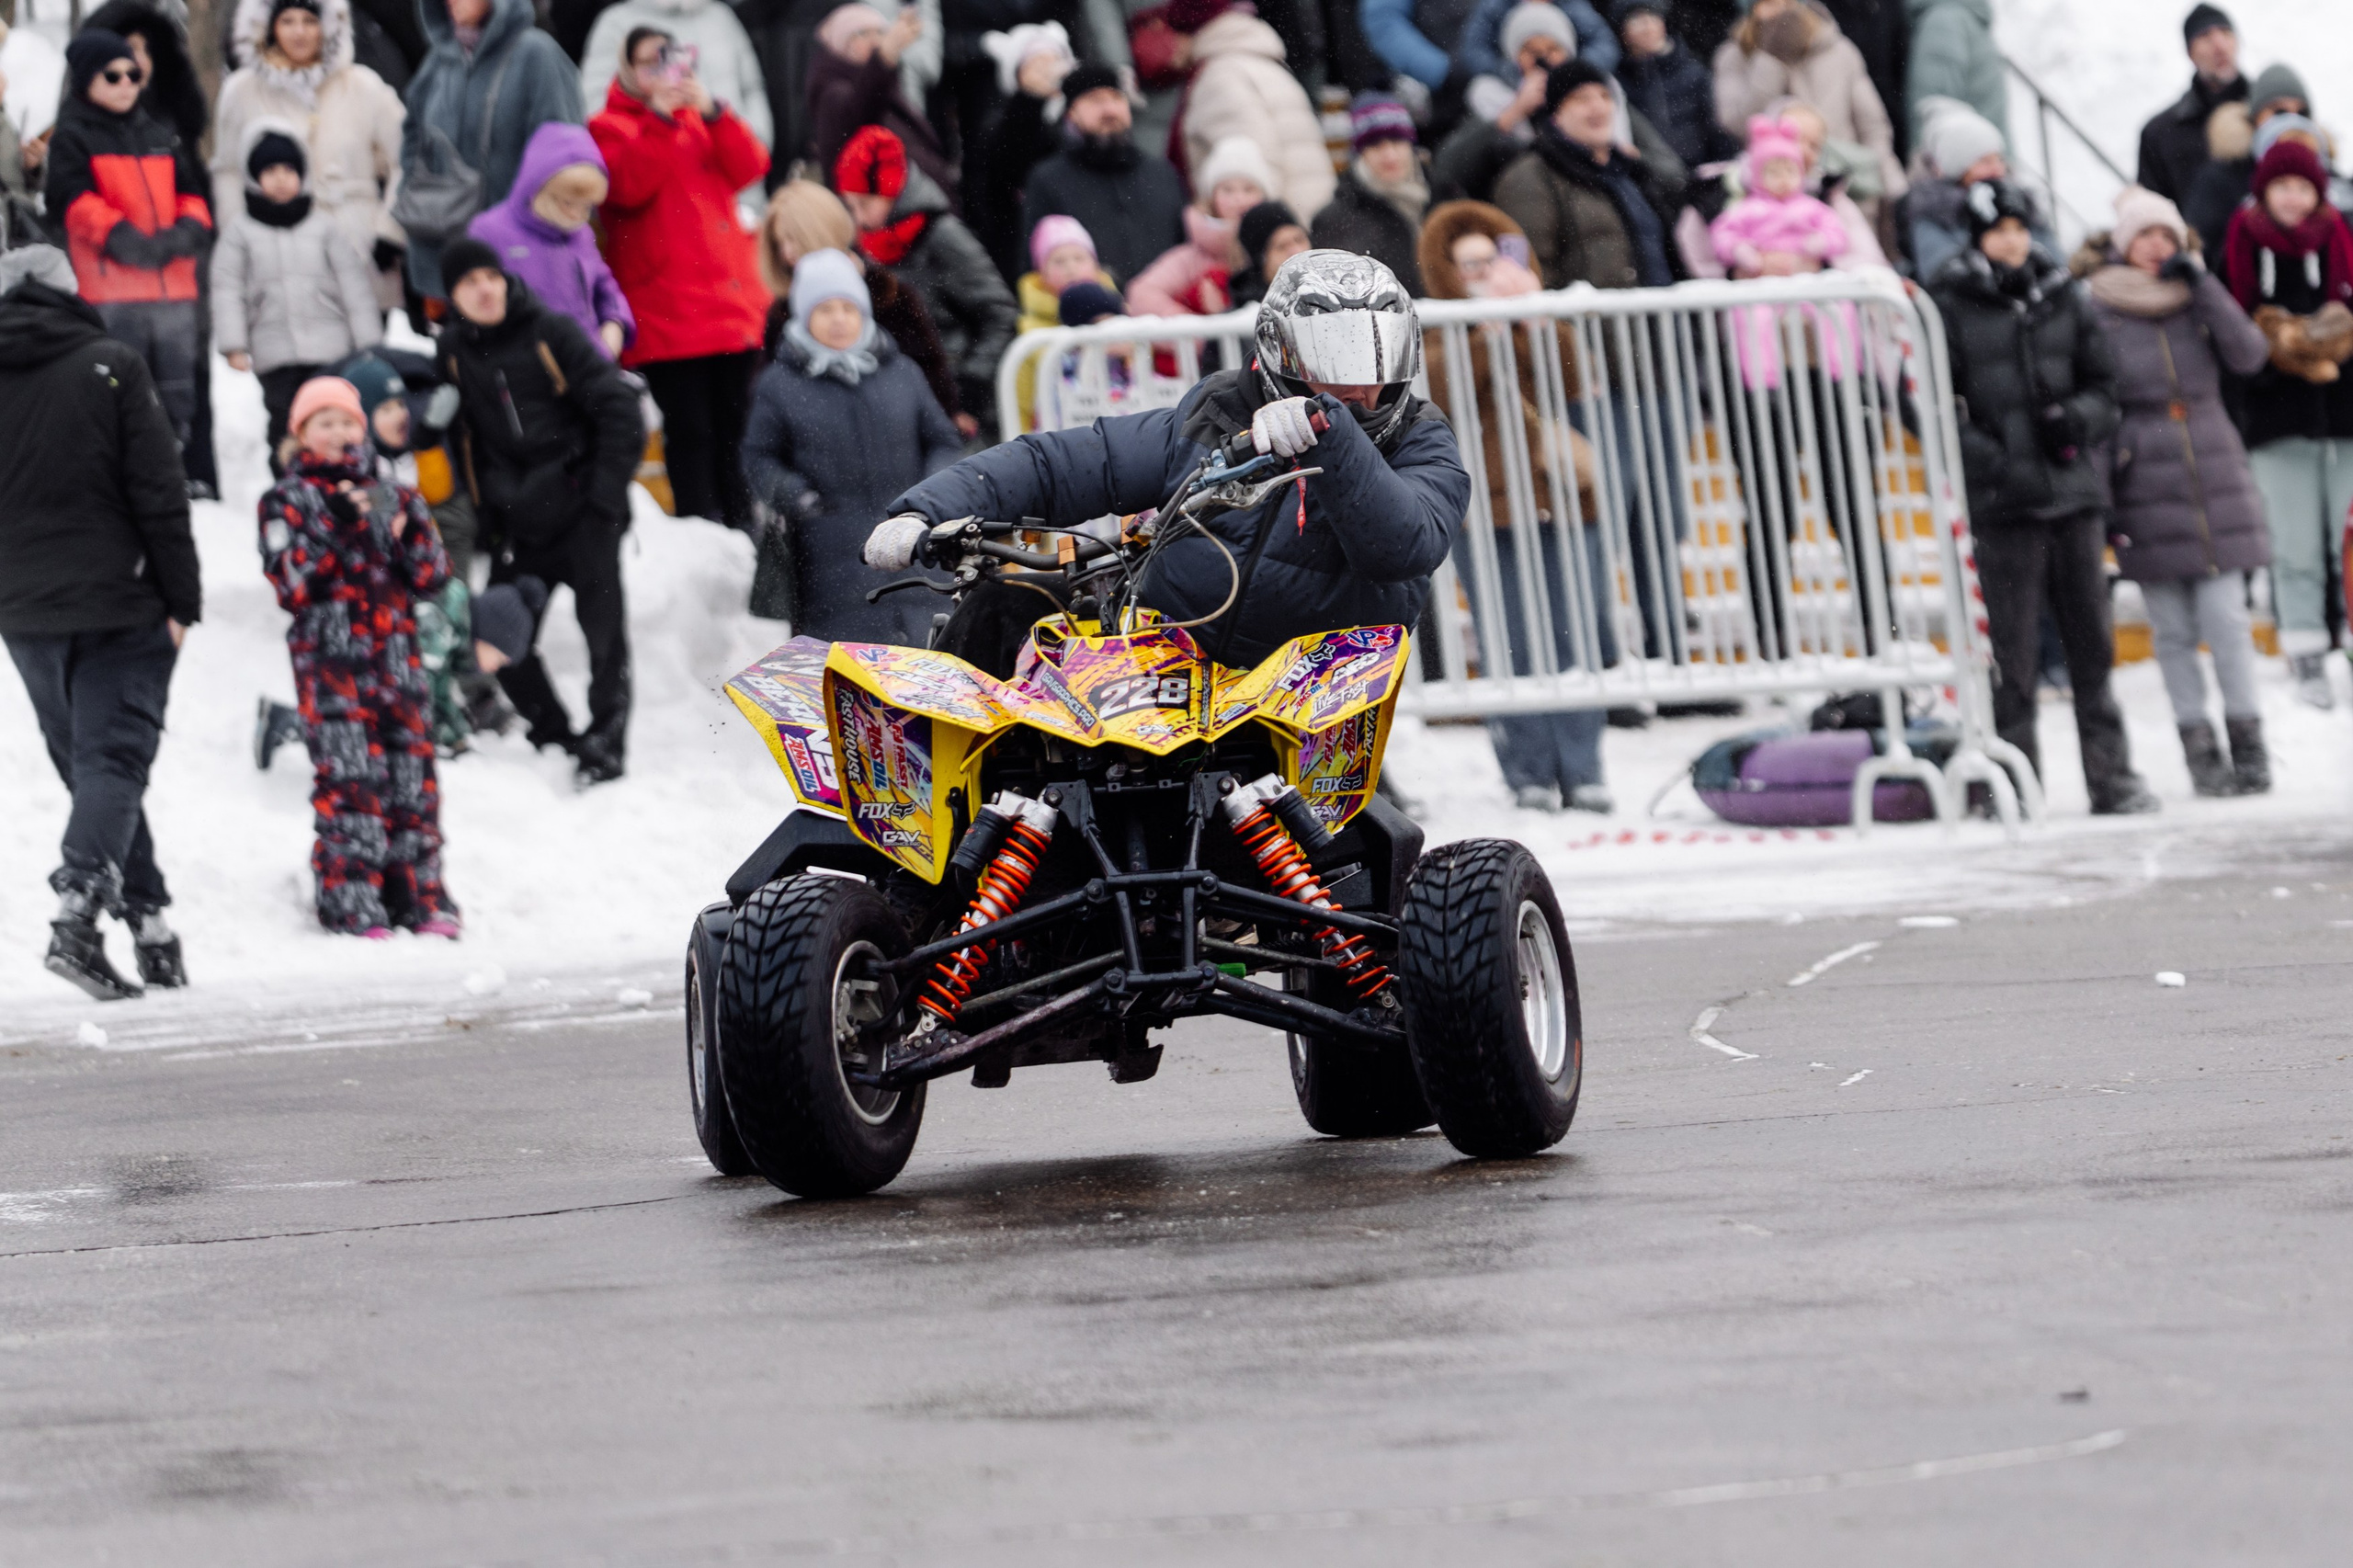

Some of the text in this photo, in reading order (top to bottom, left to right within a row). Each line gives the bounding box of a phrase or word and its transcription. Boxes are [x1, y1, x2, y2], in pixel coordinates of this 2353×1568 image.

[1347, 631, 1377, 647] VP
[858, 648, 888, 662] VP
[906, 658, 961, 678] FOX
[1278, 655, 1320, 691] FOX
[1041, 672, 1096, 727] GAVGRAPHICS.PRO
[1099, 676, 1188, 720] 228
[1291, 684, 1325, 712] AMSOIL
[839, 688, 862, 785] FASTHOUSE
[784, 733, 821, 793] AMSOIL
[866, 715, 889, 791] AMSOIL
[1313, 777, 1343, 793] FOX
[858, 803, 894, 819] FOX
[882, 830, 921, 842] GAV
